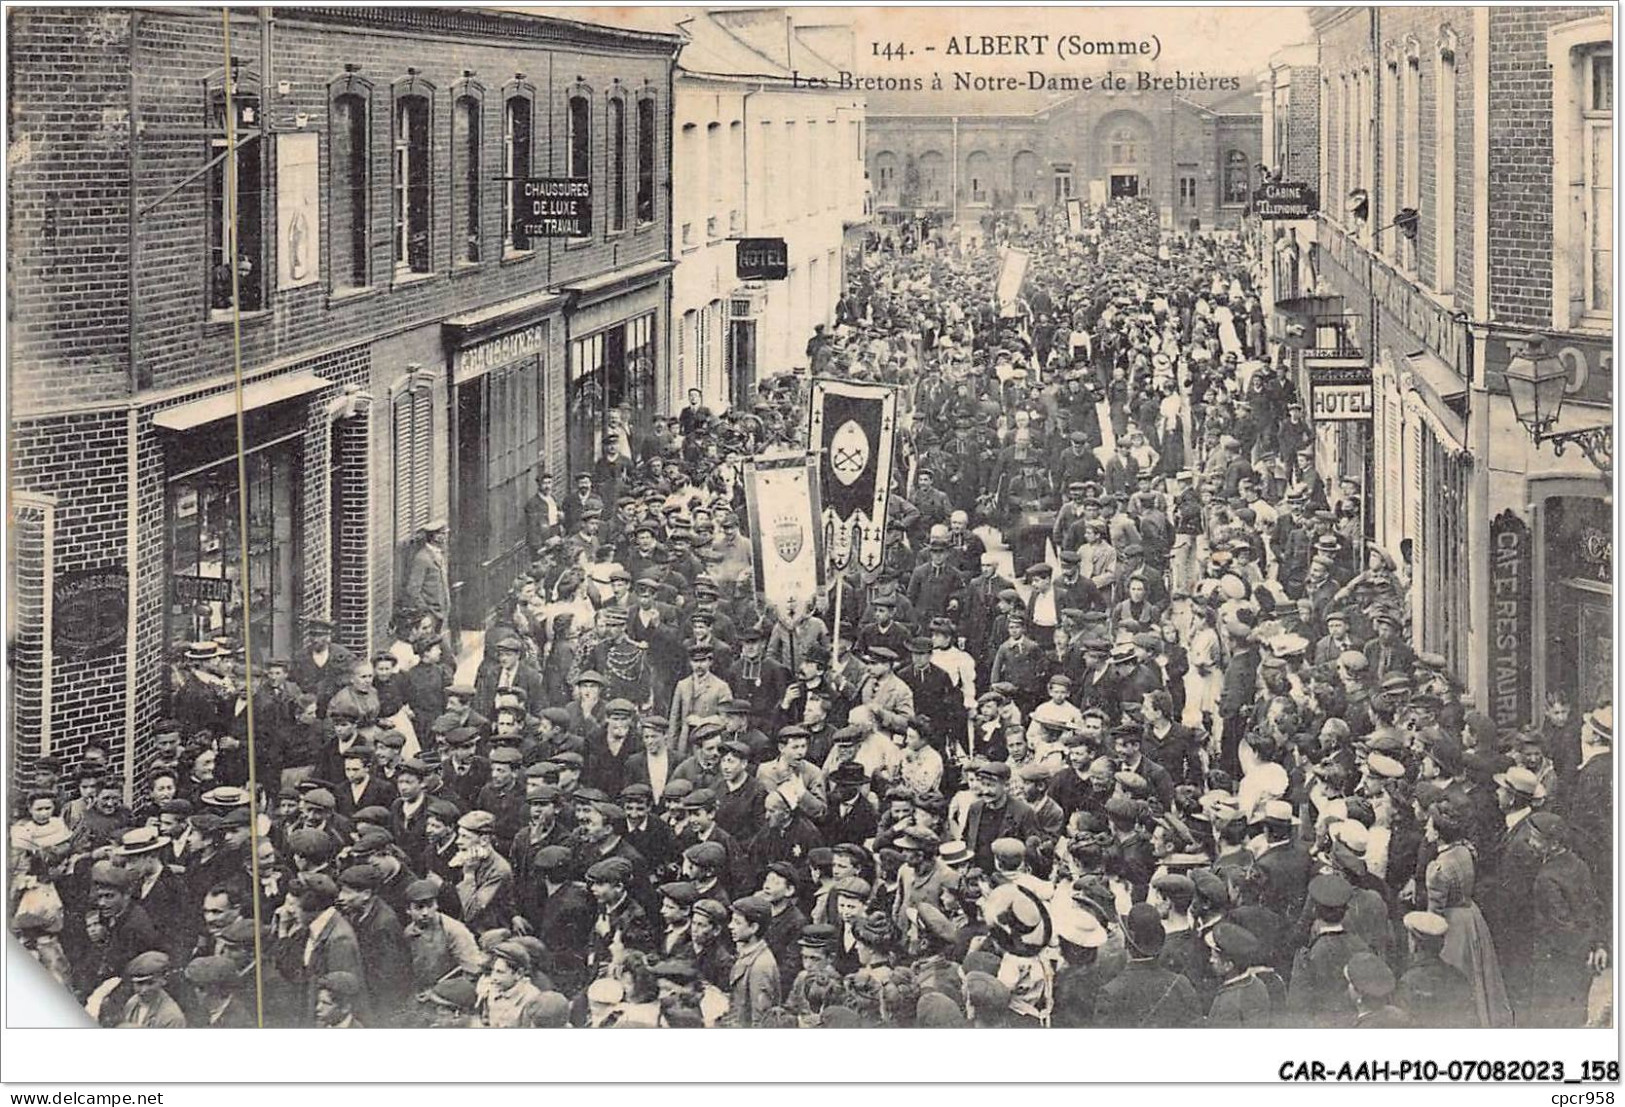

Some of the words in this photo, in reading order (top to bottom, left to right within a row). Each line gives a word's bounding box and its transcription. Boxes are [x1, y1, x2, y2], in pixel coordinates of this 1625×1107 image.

[525, 183, 589, 196] CHAUSSURES
[1266, 185, 1301, 198] CABINE
[533, 201, 547, 215] DE
[550, 201, 578, 215] LUXE
[544, 219, 581, 234] TRAVAIL
[740, 249, 785, 268] HOTEL
[1314, 392, 1371, 413] HOTEL
